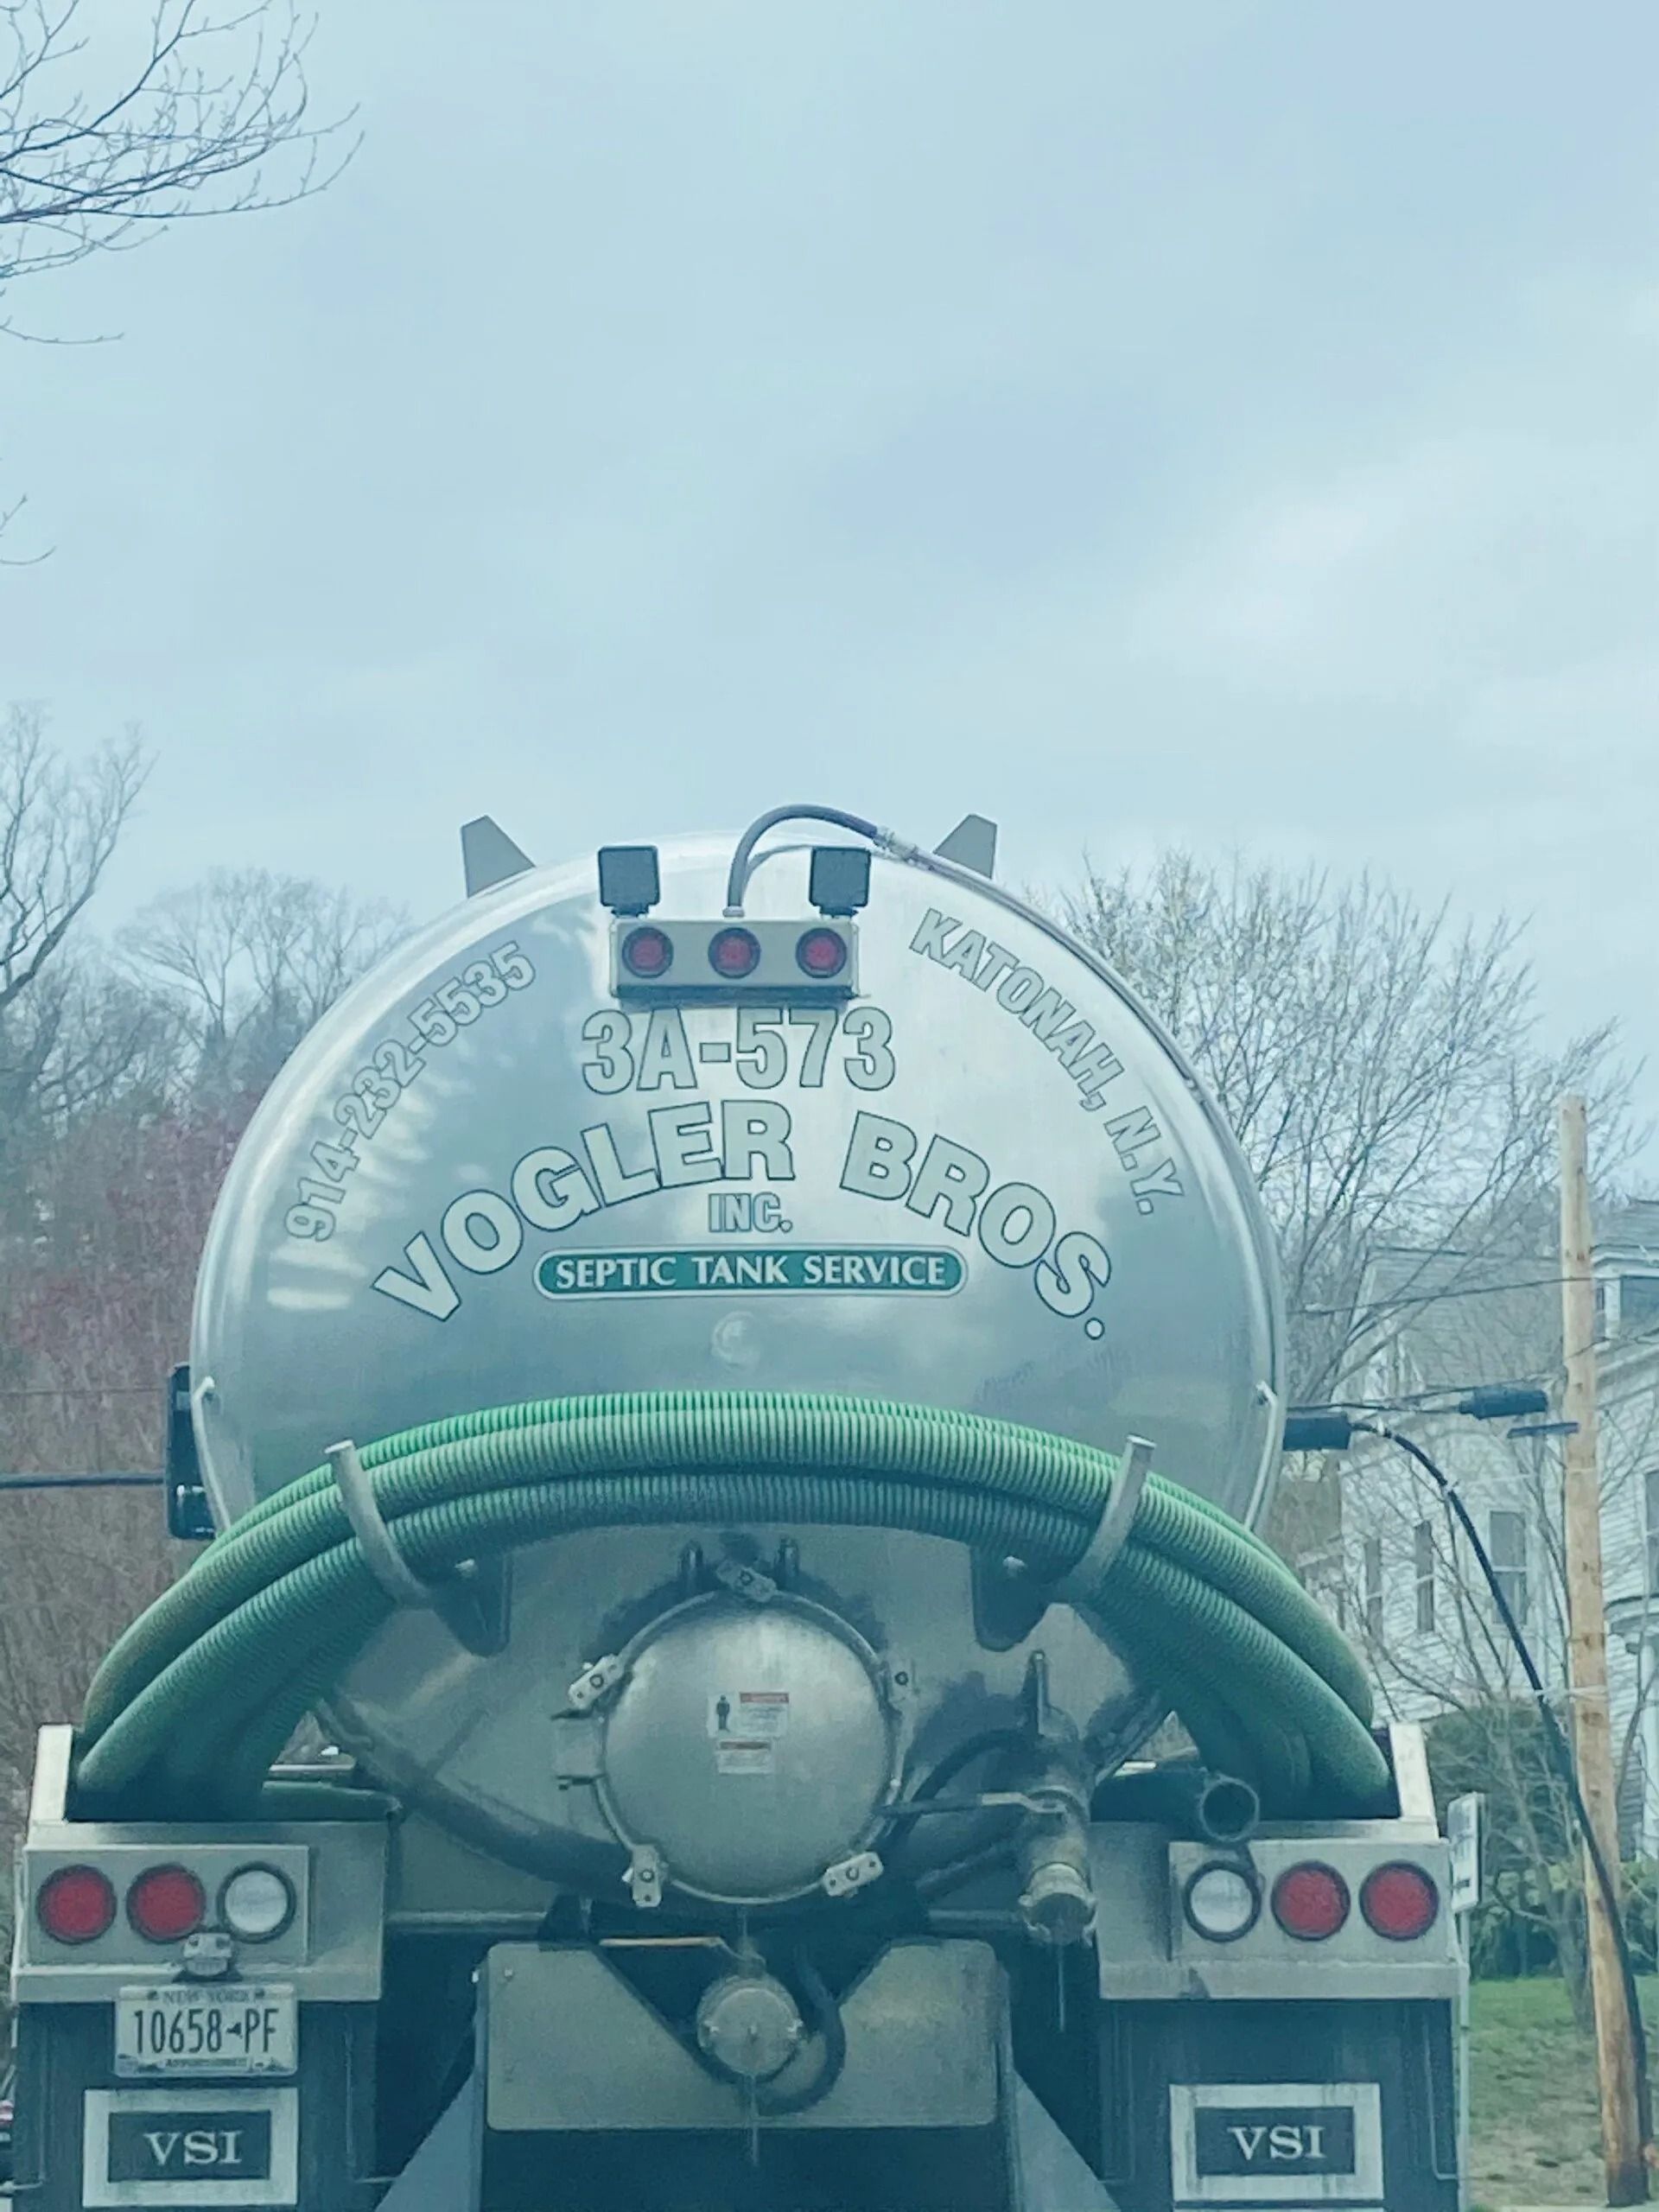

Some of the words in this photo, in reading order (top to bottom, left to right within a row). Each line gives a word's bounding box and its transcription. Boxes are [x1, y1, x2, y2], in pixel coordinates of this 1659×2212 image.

[582, 1006, 896, 1095] 3A-573
[908, 907, 1125, 1111] KATONAH,
[1103, 1105, 1185, 1215] N.Y.
[284, 940, 536, 1242] 914-232-5535
[371, 1099, 796, 1322] VOGLER
[840, 1110, 1112, 1340] BROS.
[708, 1192, 793, 1233] INC.
[556, 1256, 677, 1288] SEPTIC
[693, 1255, 789, 1286] TANK
[803, 1255, 946, 1286] SERVICE
[143, 2131, 243, 2165] VSI
[1228, 2125, 1326, 2160] VSI
